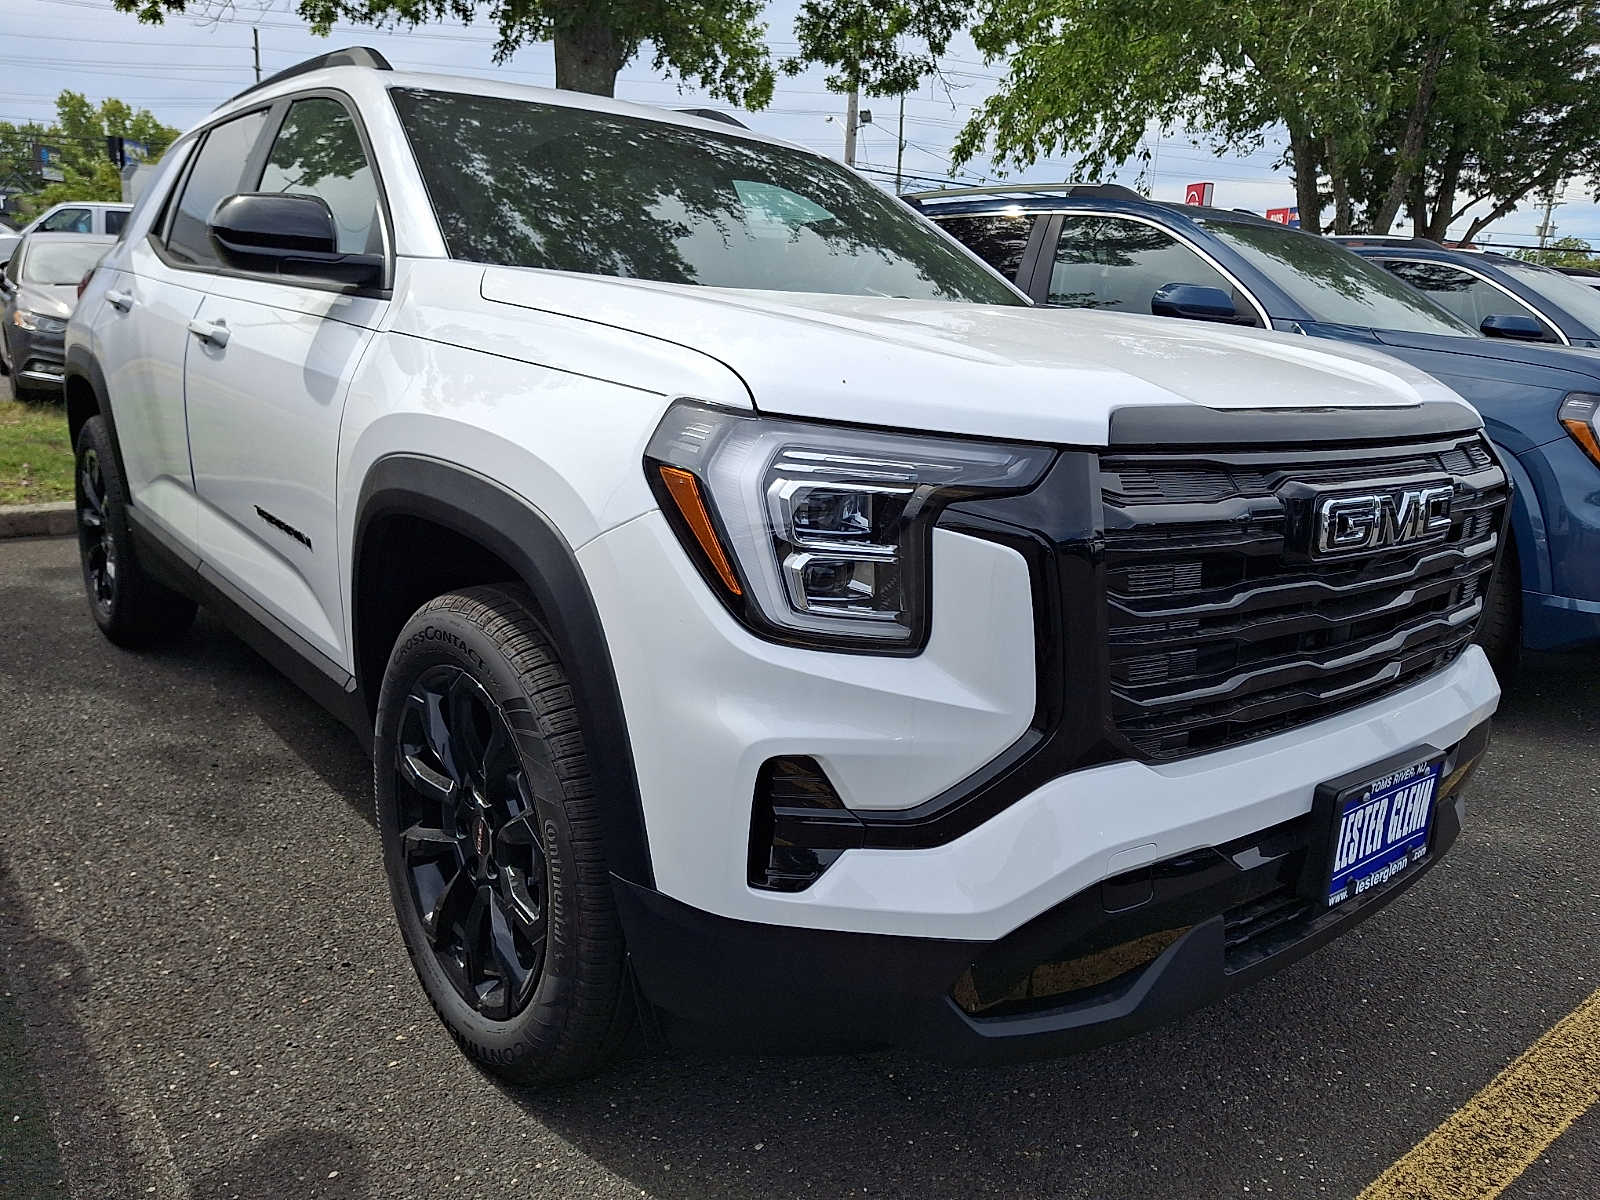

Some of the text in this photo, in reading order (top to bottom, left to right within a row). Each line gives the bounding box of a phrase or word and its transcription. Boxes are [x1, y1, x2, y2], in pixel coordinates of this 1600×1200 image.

[1319, 485, 1454, 552] GMC
[1371, 777, 1392, 794] TOMS
[1416, 762, 1428, 775] NJ
[1334, 778, 1435, 873] LESTER GLENN
[1355, 857, 1408, 895] lesterglenn
